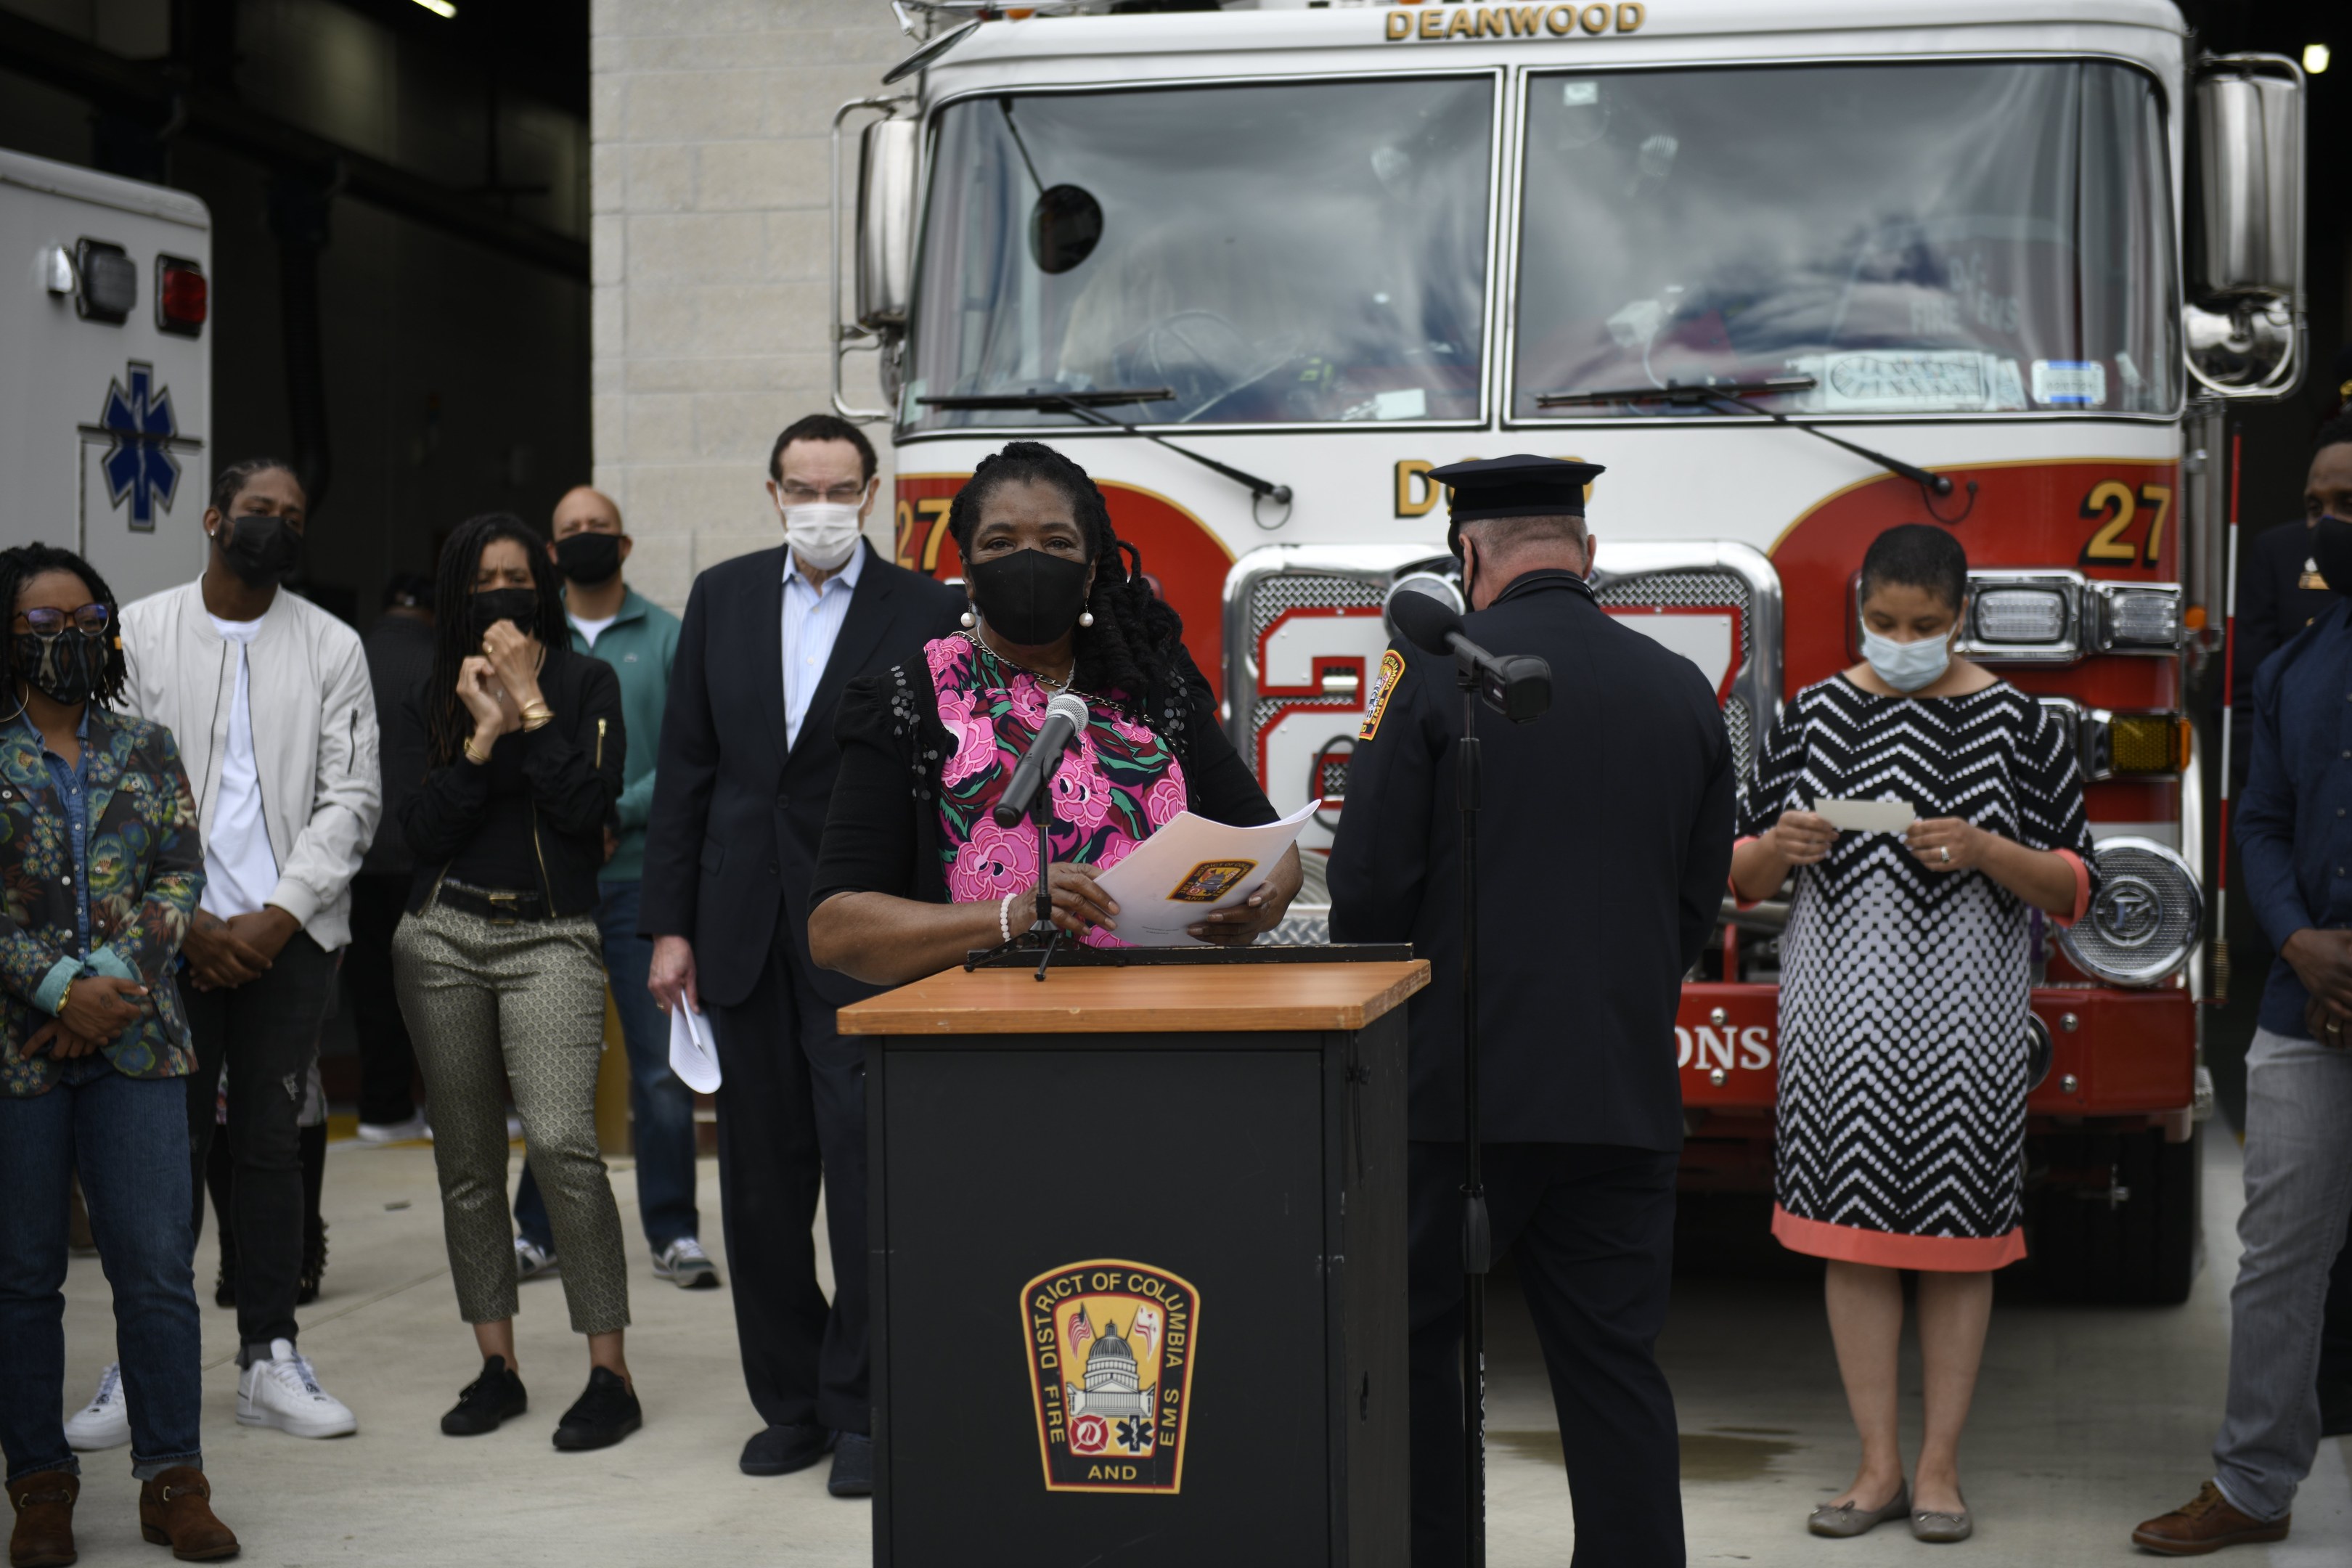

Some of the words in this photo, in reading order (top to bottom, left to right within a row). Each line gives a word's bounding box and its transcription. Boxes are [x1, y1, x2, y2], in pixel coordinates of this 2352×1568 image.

[1386, 2, 1646, 41] DEANWOOD
[897, 497, 953, 575] 27
[2080, 480, 2171, 567] 27
[1384, 656, 1399, 691] COLUMBIA
[1371, 698, 1384, 725] EMS
[1194, 862, 1225, 877] DISTRICT
[1178, 882, 1194, 894] FIRE
[1212, 885, 1230, 897] EMS
[1034, 1274, 1085, 1369] DISTRICT
[1092, 1273, 1122, 1291] OF
[1127, 1273, 1188, 1368] COLUMBIA
[1044, 1385, 1066, 1445] FIRE
[1087, 1465, 1137, 1480] AND
[1159, 1387, 1180, 1447] EMS
